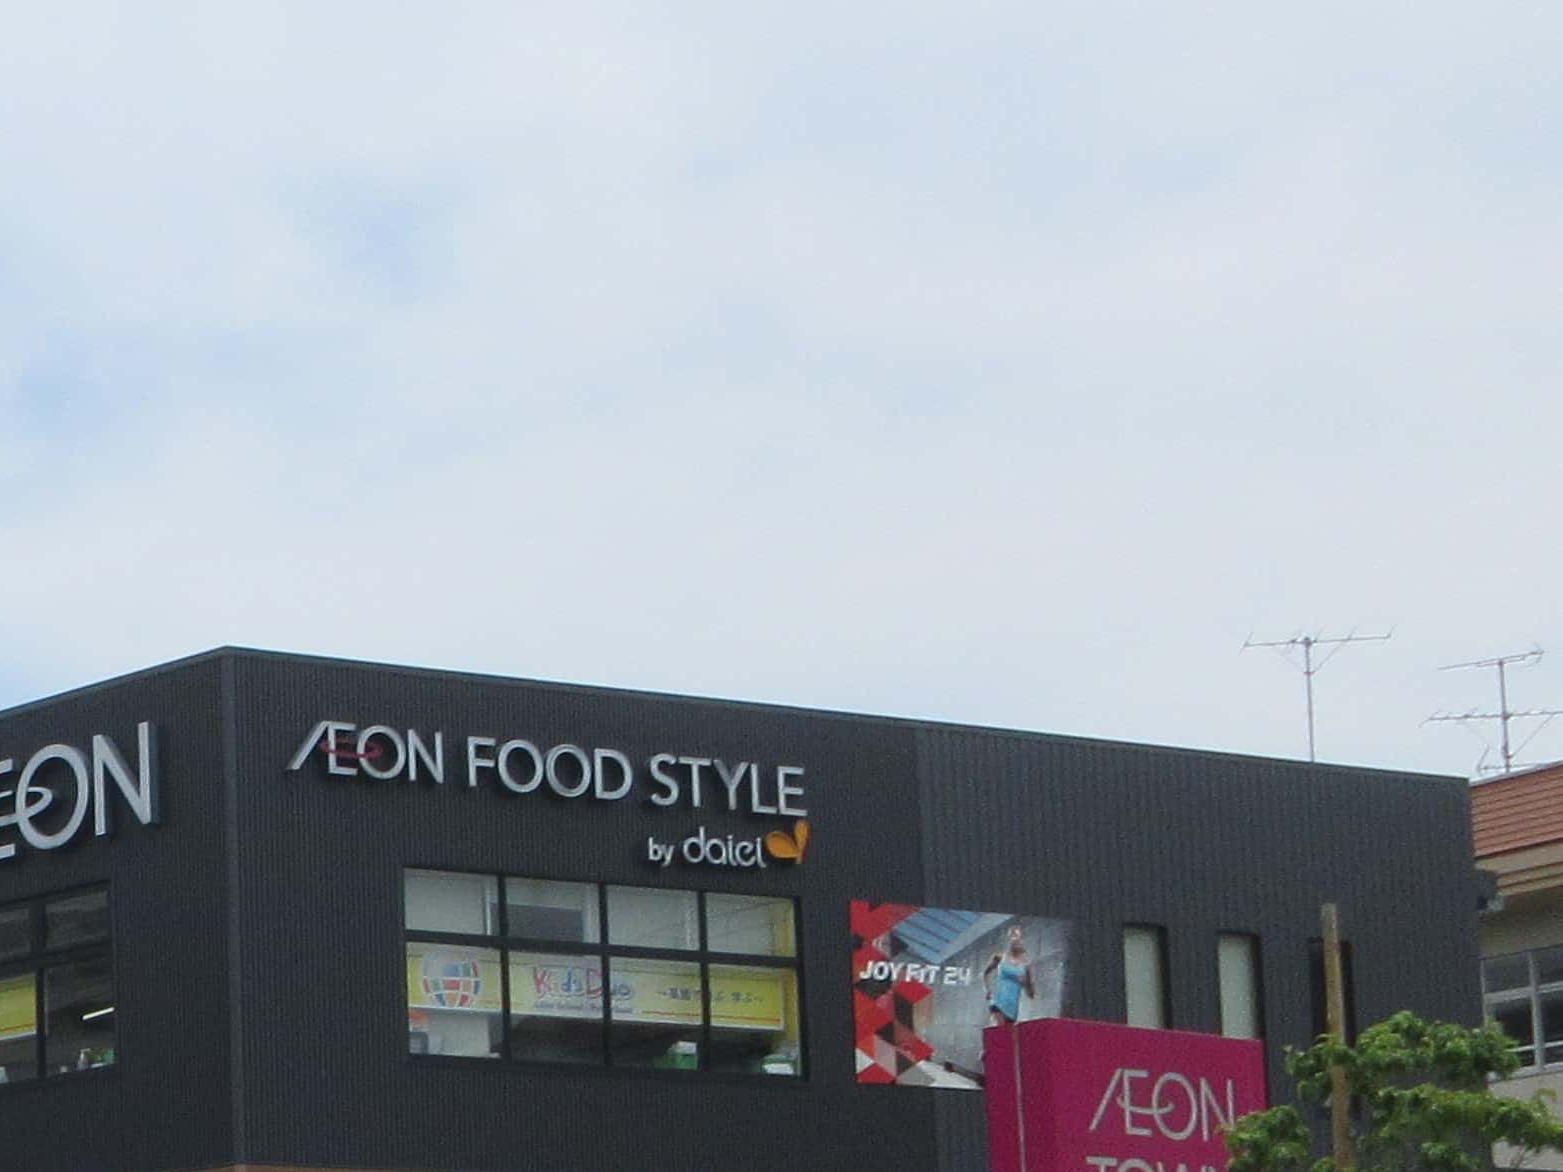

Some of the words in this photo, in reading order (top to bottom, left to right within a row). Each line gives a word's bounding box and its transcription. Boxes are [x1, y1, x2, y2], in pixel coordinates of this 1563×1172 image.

[467, 736, 633, 801] FOOD
[650, 753, 808, 817] STYLE
[647, 837, 675, 867] by
